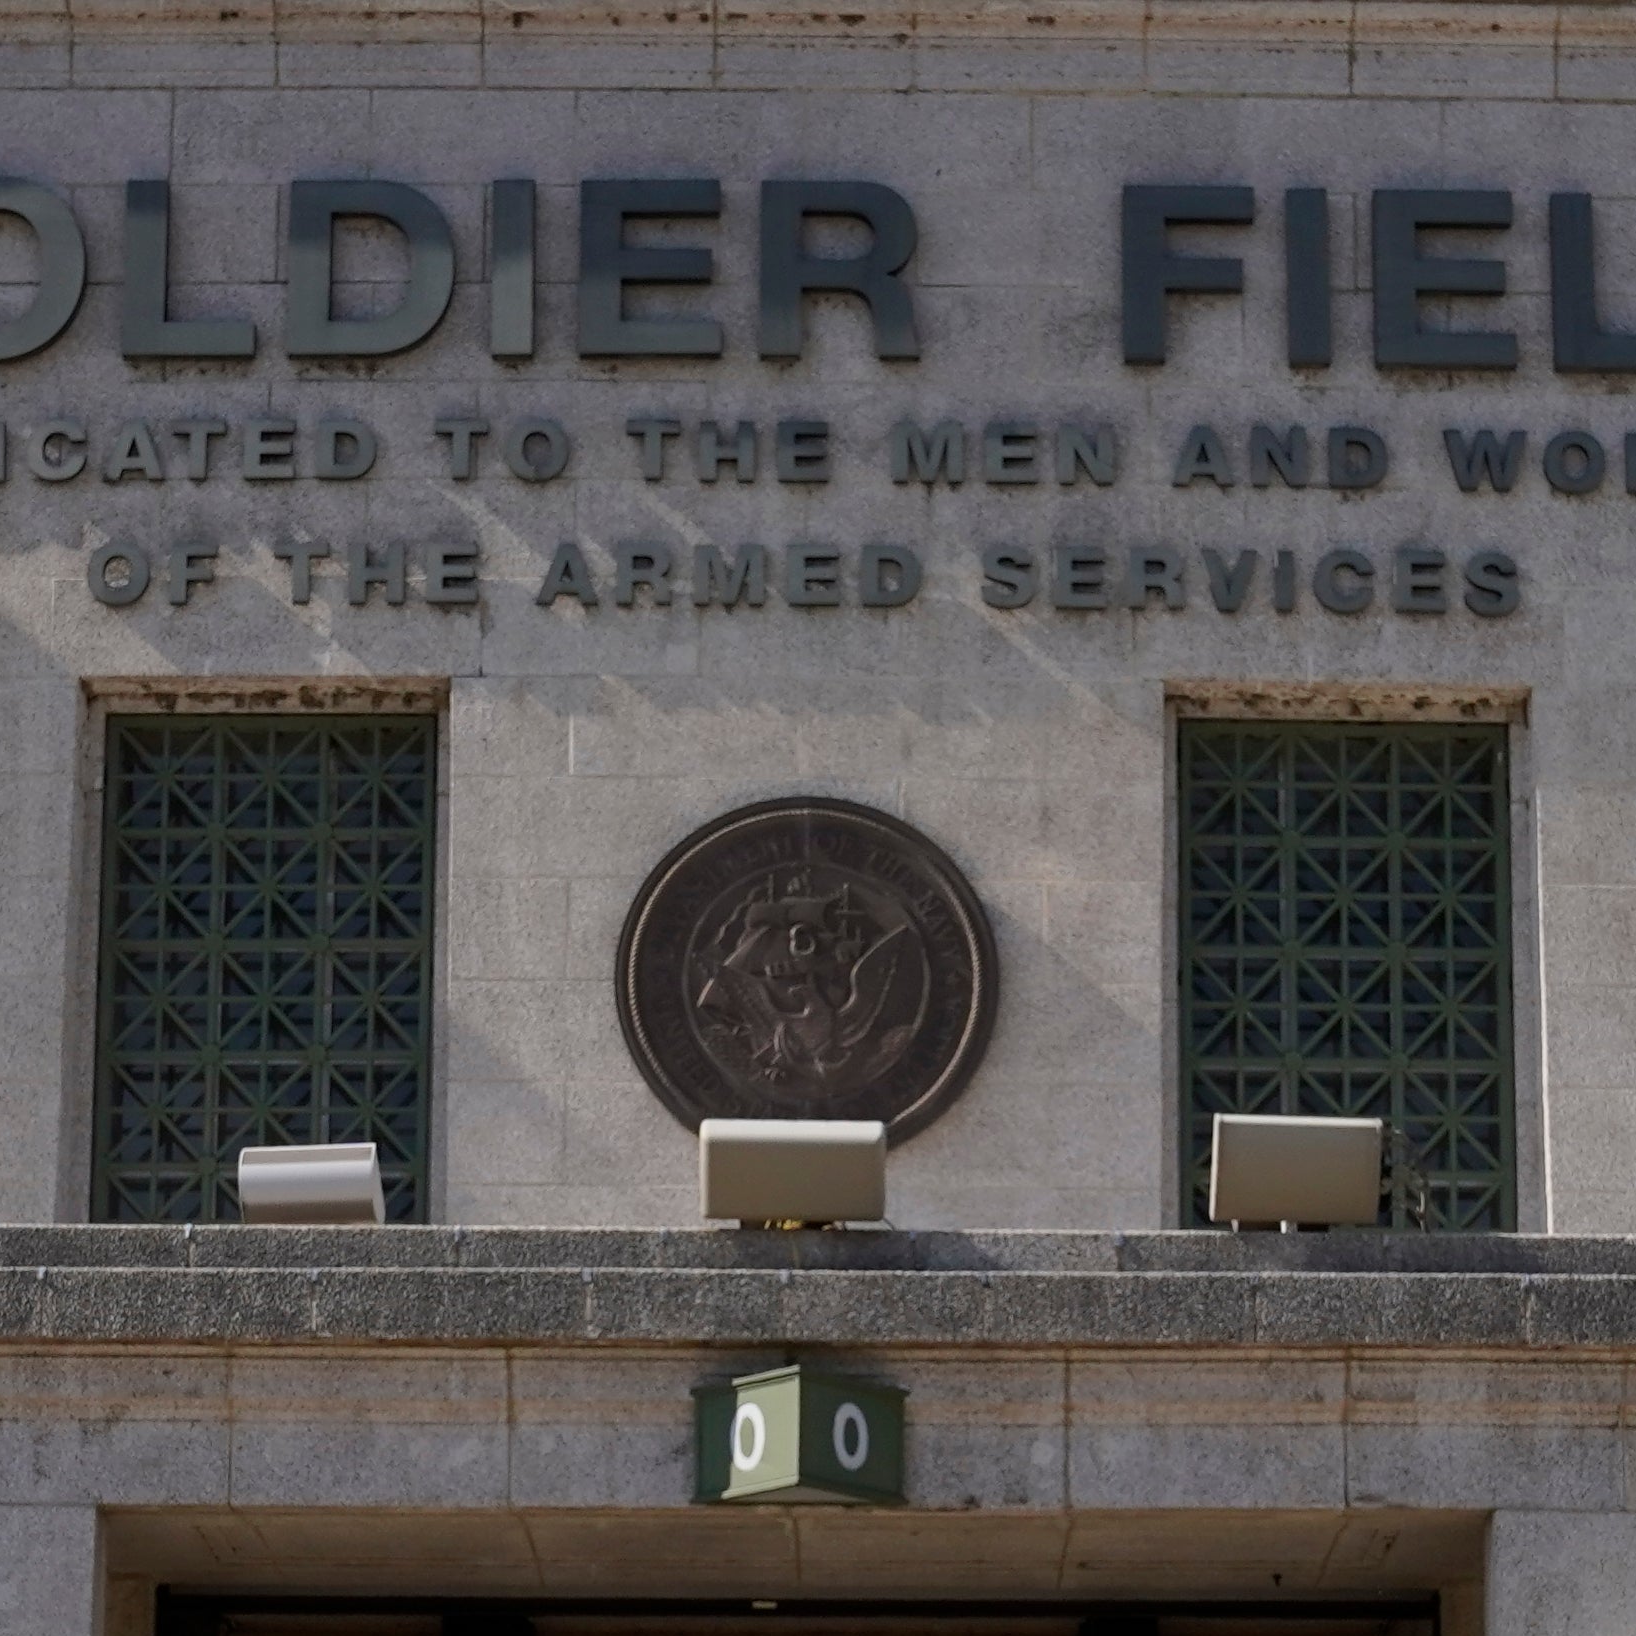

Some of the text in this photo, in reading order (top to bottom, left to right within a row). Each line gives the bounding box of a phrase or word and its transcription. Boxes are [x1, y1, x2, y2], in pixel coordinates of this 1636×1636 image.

[434, 418, 571, 485] TO
[626, 418, 832, 486] THE
[889, 419, 1118, 487] MEN
[1173, 423, 1389, 492] AND
[85, 539, 1520, 619] OF THE ARMED SERVICES
[833, 1402, 870, 1471] 0
